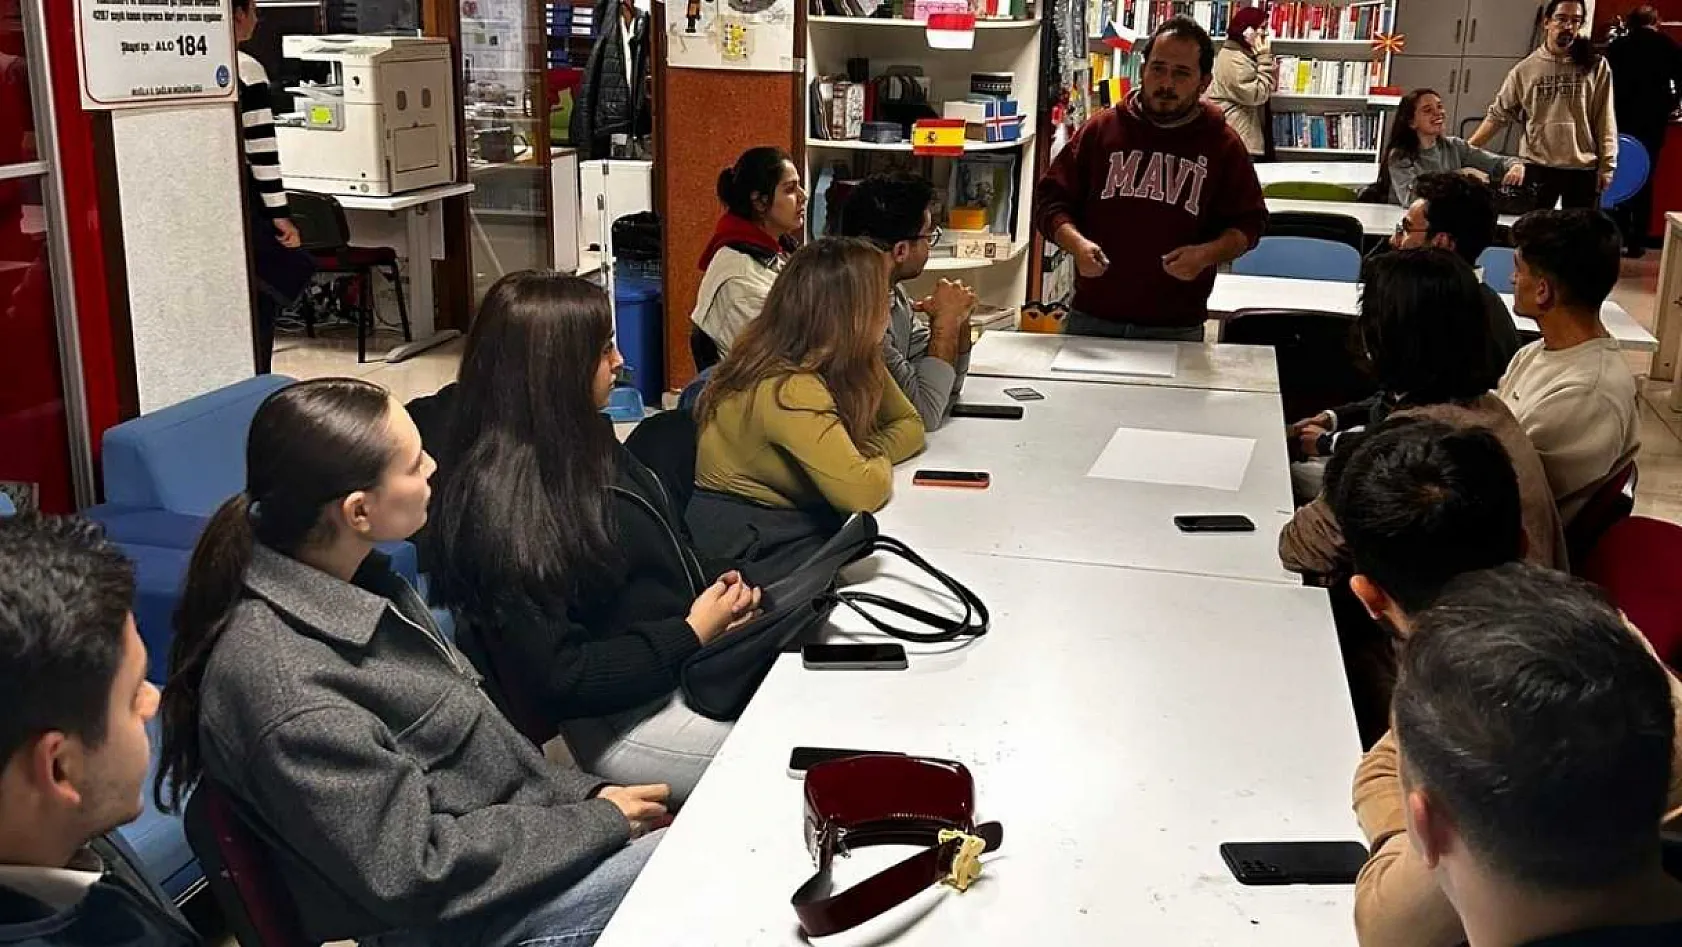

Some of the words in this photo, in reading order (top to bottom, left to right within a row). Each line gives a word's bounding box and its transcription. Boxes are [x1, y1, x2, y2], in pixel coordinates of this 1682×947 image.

[155, 41, 174, 51] ALO
[176, 35, 208, 56] 184
[1100, 149, 1208, 216] MAVİ
